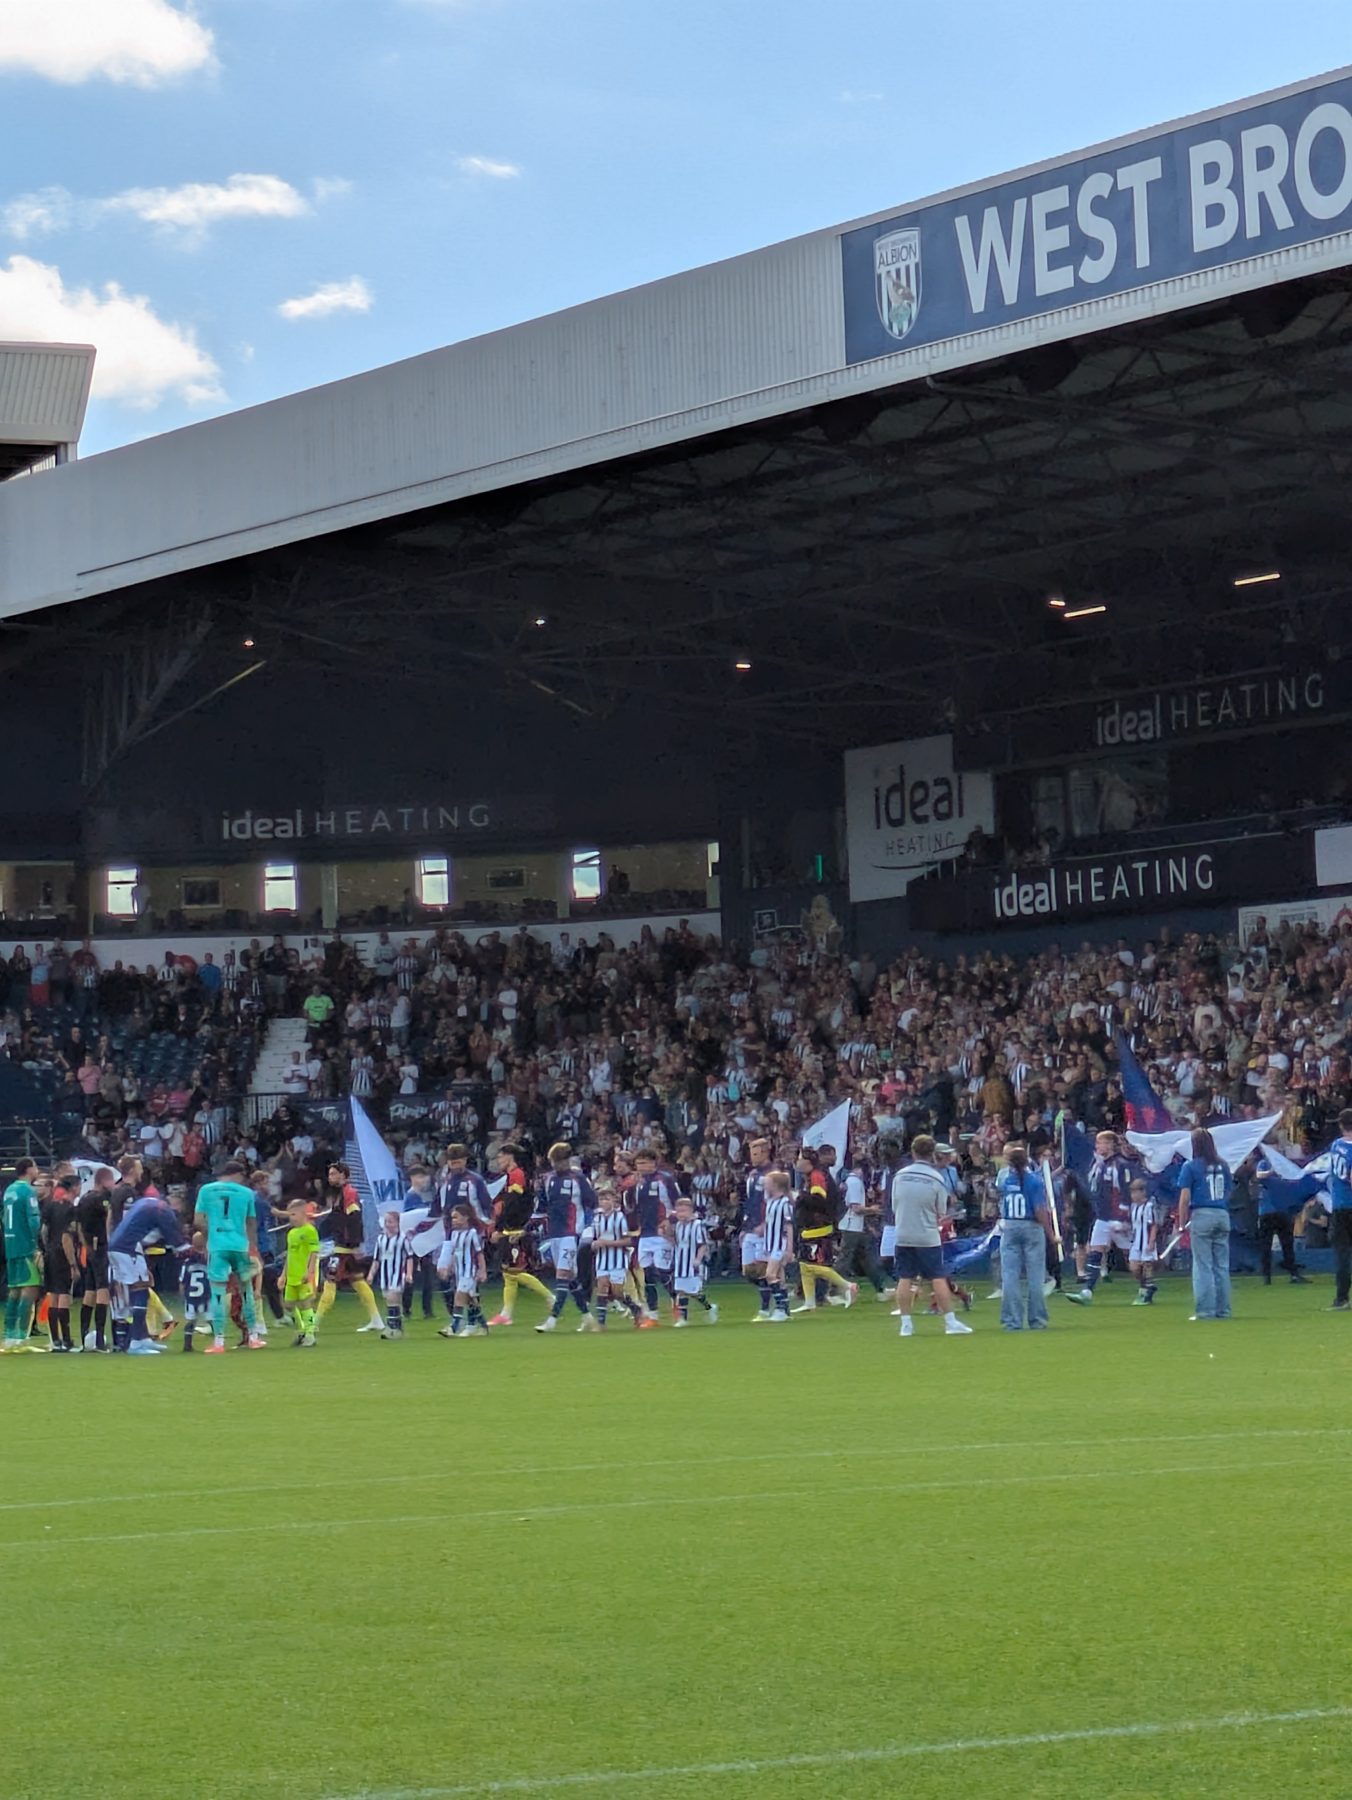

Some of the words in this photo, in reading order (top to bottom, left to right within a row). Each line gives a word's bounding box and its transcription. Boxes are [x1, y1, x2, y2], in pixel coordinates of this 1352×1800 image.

[955, 156, 1163, 314] WEST
[1189, 102, 1352, 253] BRO
[878, 242, 917, 269] ALBION
[1096, 694, 1162, 745] ideal
[1171, 673, 1323, 730] HEATING
[874, 764, 964, 830] ideal
[222, 809, 302, 840] ideal
[315, 804, 490, 835] HEATING
[994, 868, 1057, 918] ideal
[1066, 854, 1213, 905] HEATING
[1205, 1174, 1225, 1201] 10
[6, 1204, 14, 1230] 1
[219, 1195, 231, 1220] 1
[1005, 1193, 1026, 1219] 10
[188, 1272, 206, 1298] 5
